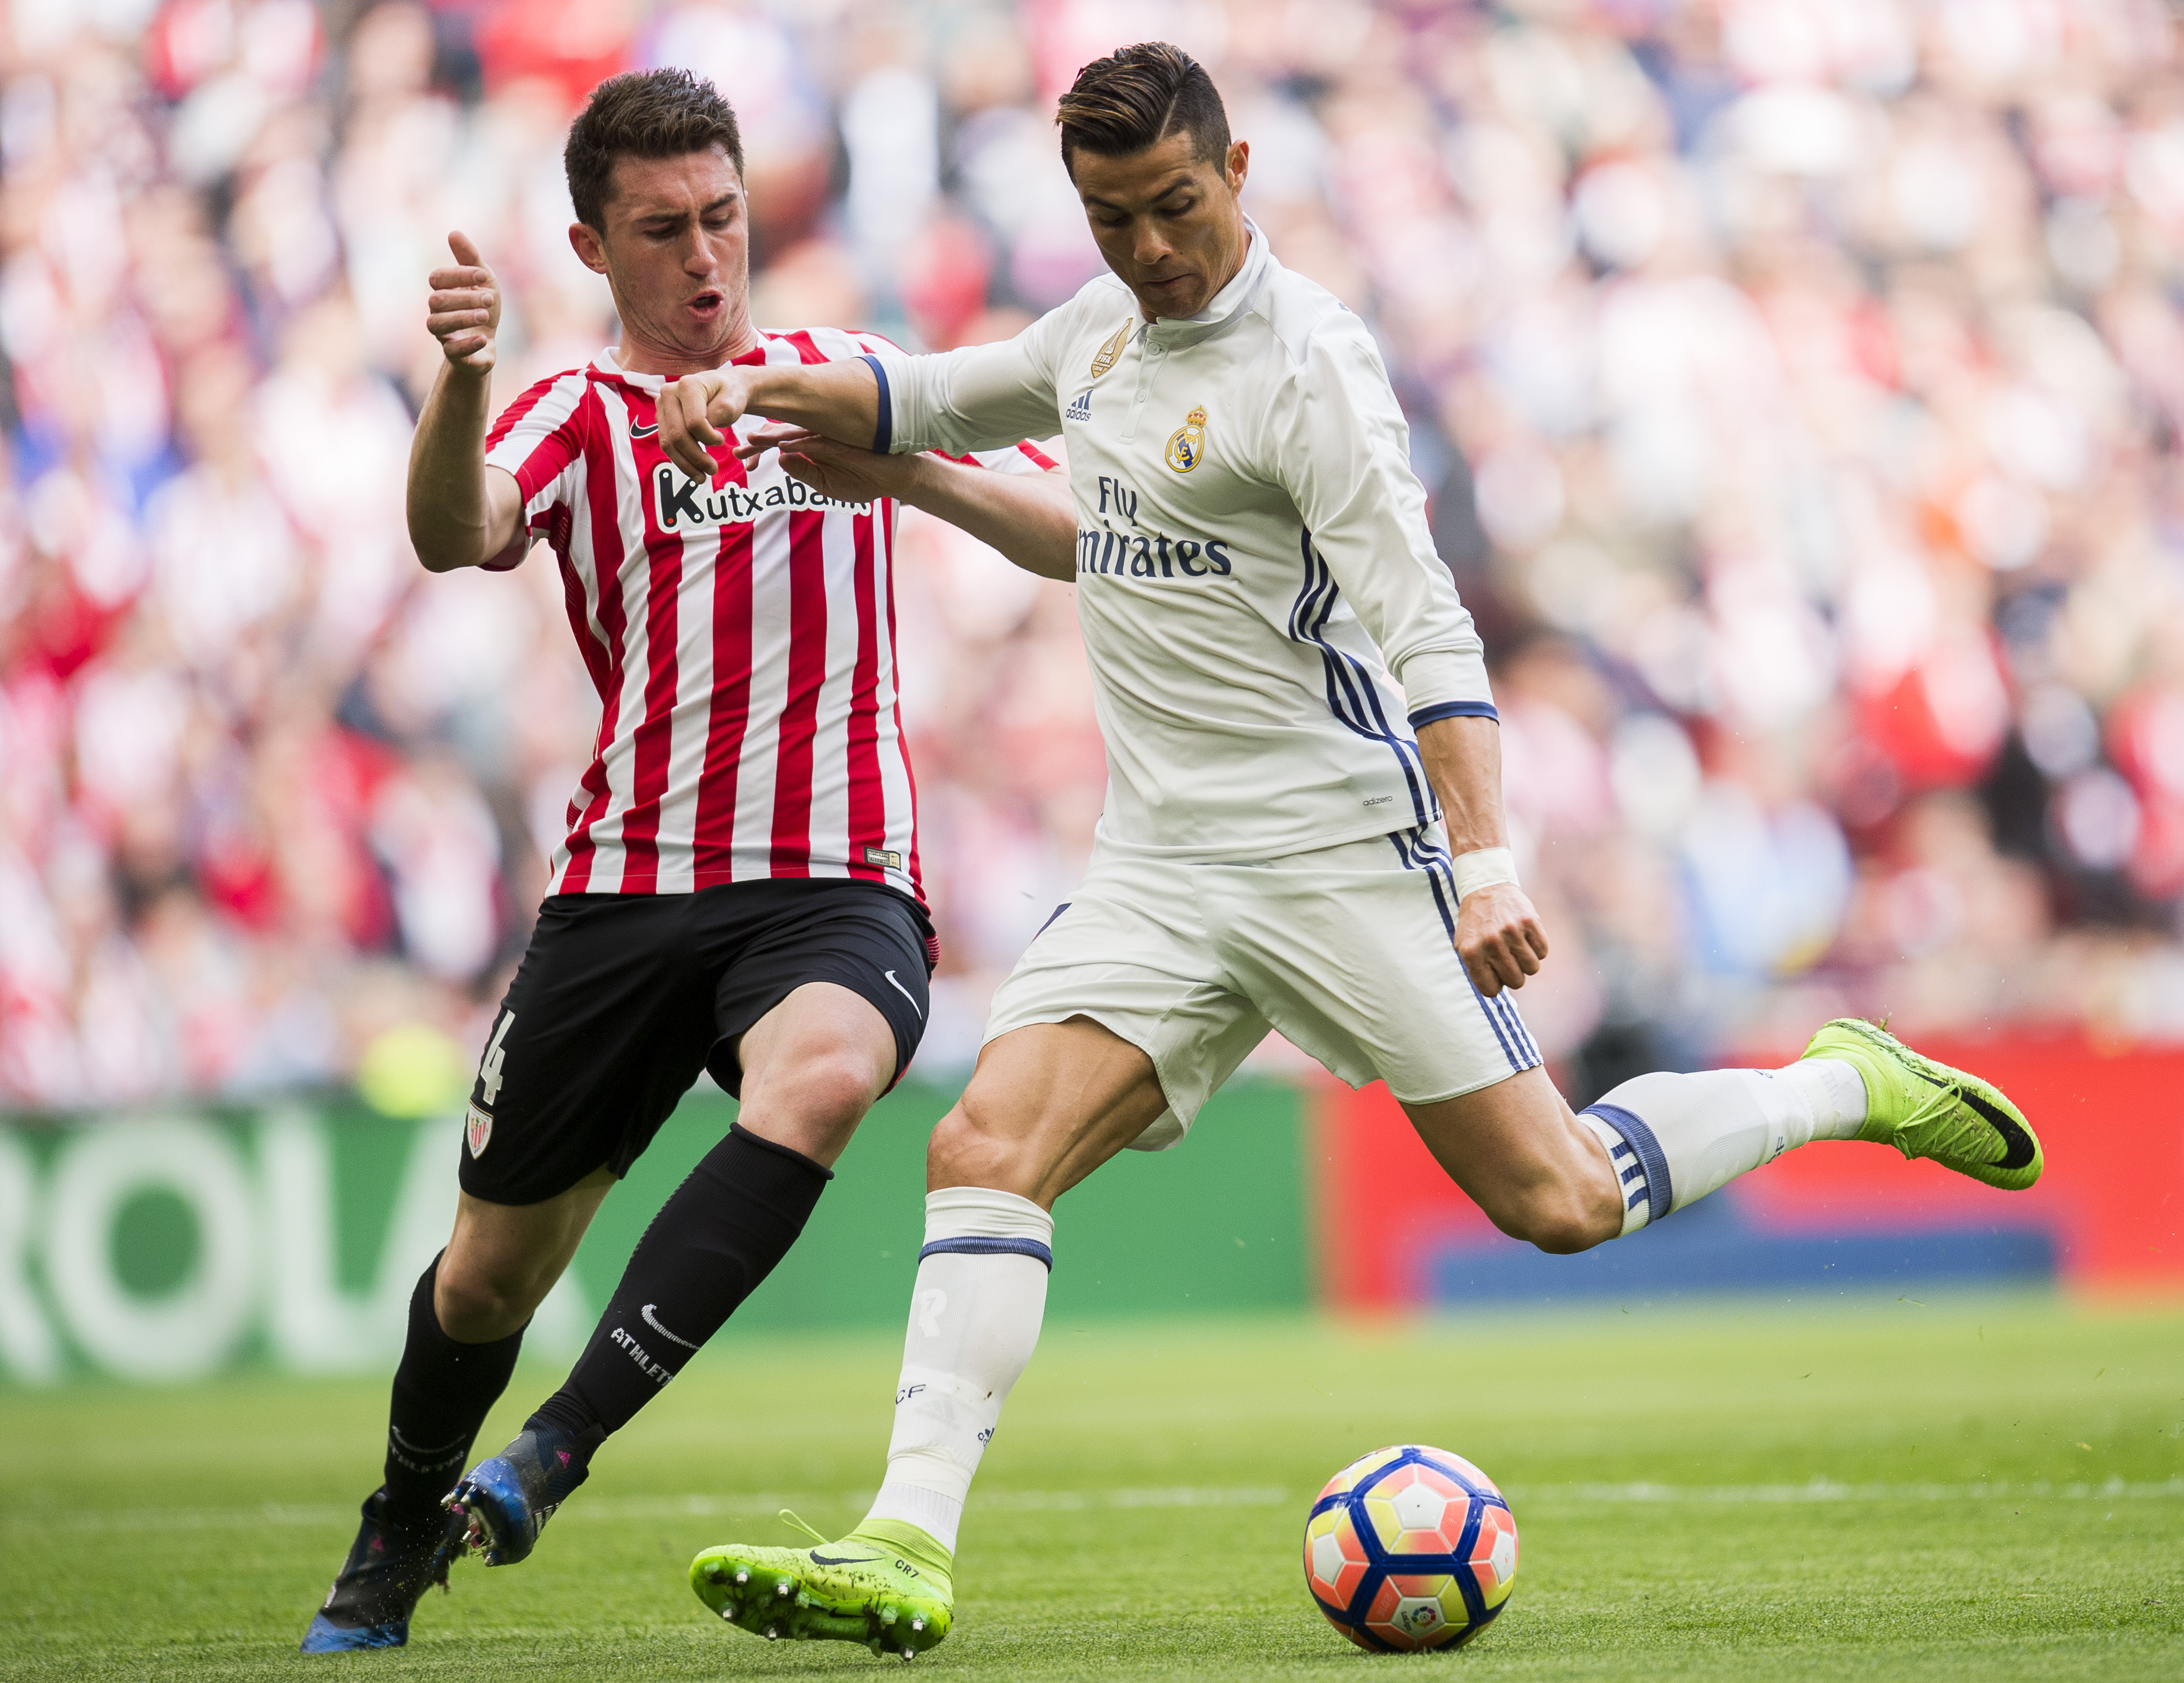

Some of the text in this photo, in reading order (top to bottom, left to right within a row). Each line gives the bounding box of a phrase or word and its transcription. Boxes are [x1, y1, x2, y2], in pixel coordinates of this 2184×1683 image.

[1097, 354, 1112, 364] FIFA
[1066, 407, 1091, 421] adidas
[1099, 476, 1137, 527] Fly
[1363, 796, 1393, 806] adizero
[480, 1009, 516, 1106] 4
[895, 1559, 919, 1578] CR7
